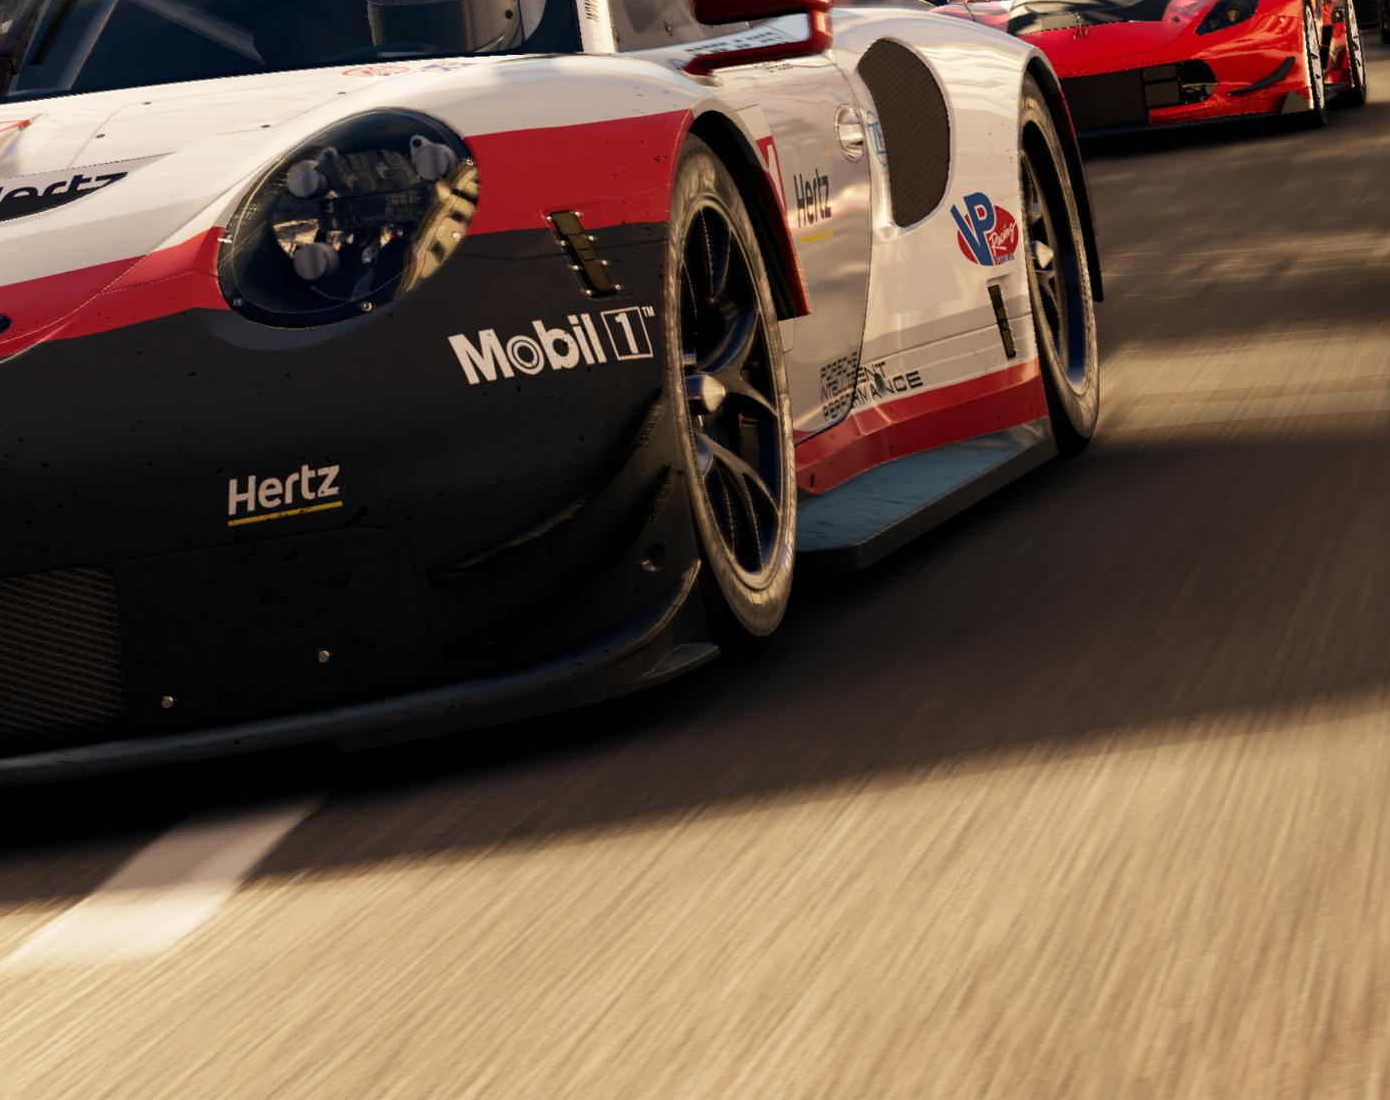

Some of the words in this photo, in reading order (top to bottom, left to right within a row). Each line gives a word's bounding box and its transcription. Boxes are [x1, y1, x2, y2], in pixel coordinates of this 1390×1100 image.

[793, 168, 832, 229] Hertz
[950, 191, 995, 267] VP
[447, 313, 608, 385] Mobil
[228, 464, 340, 516] Hertz
